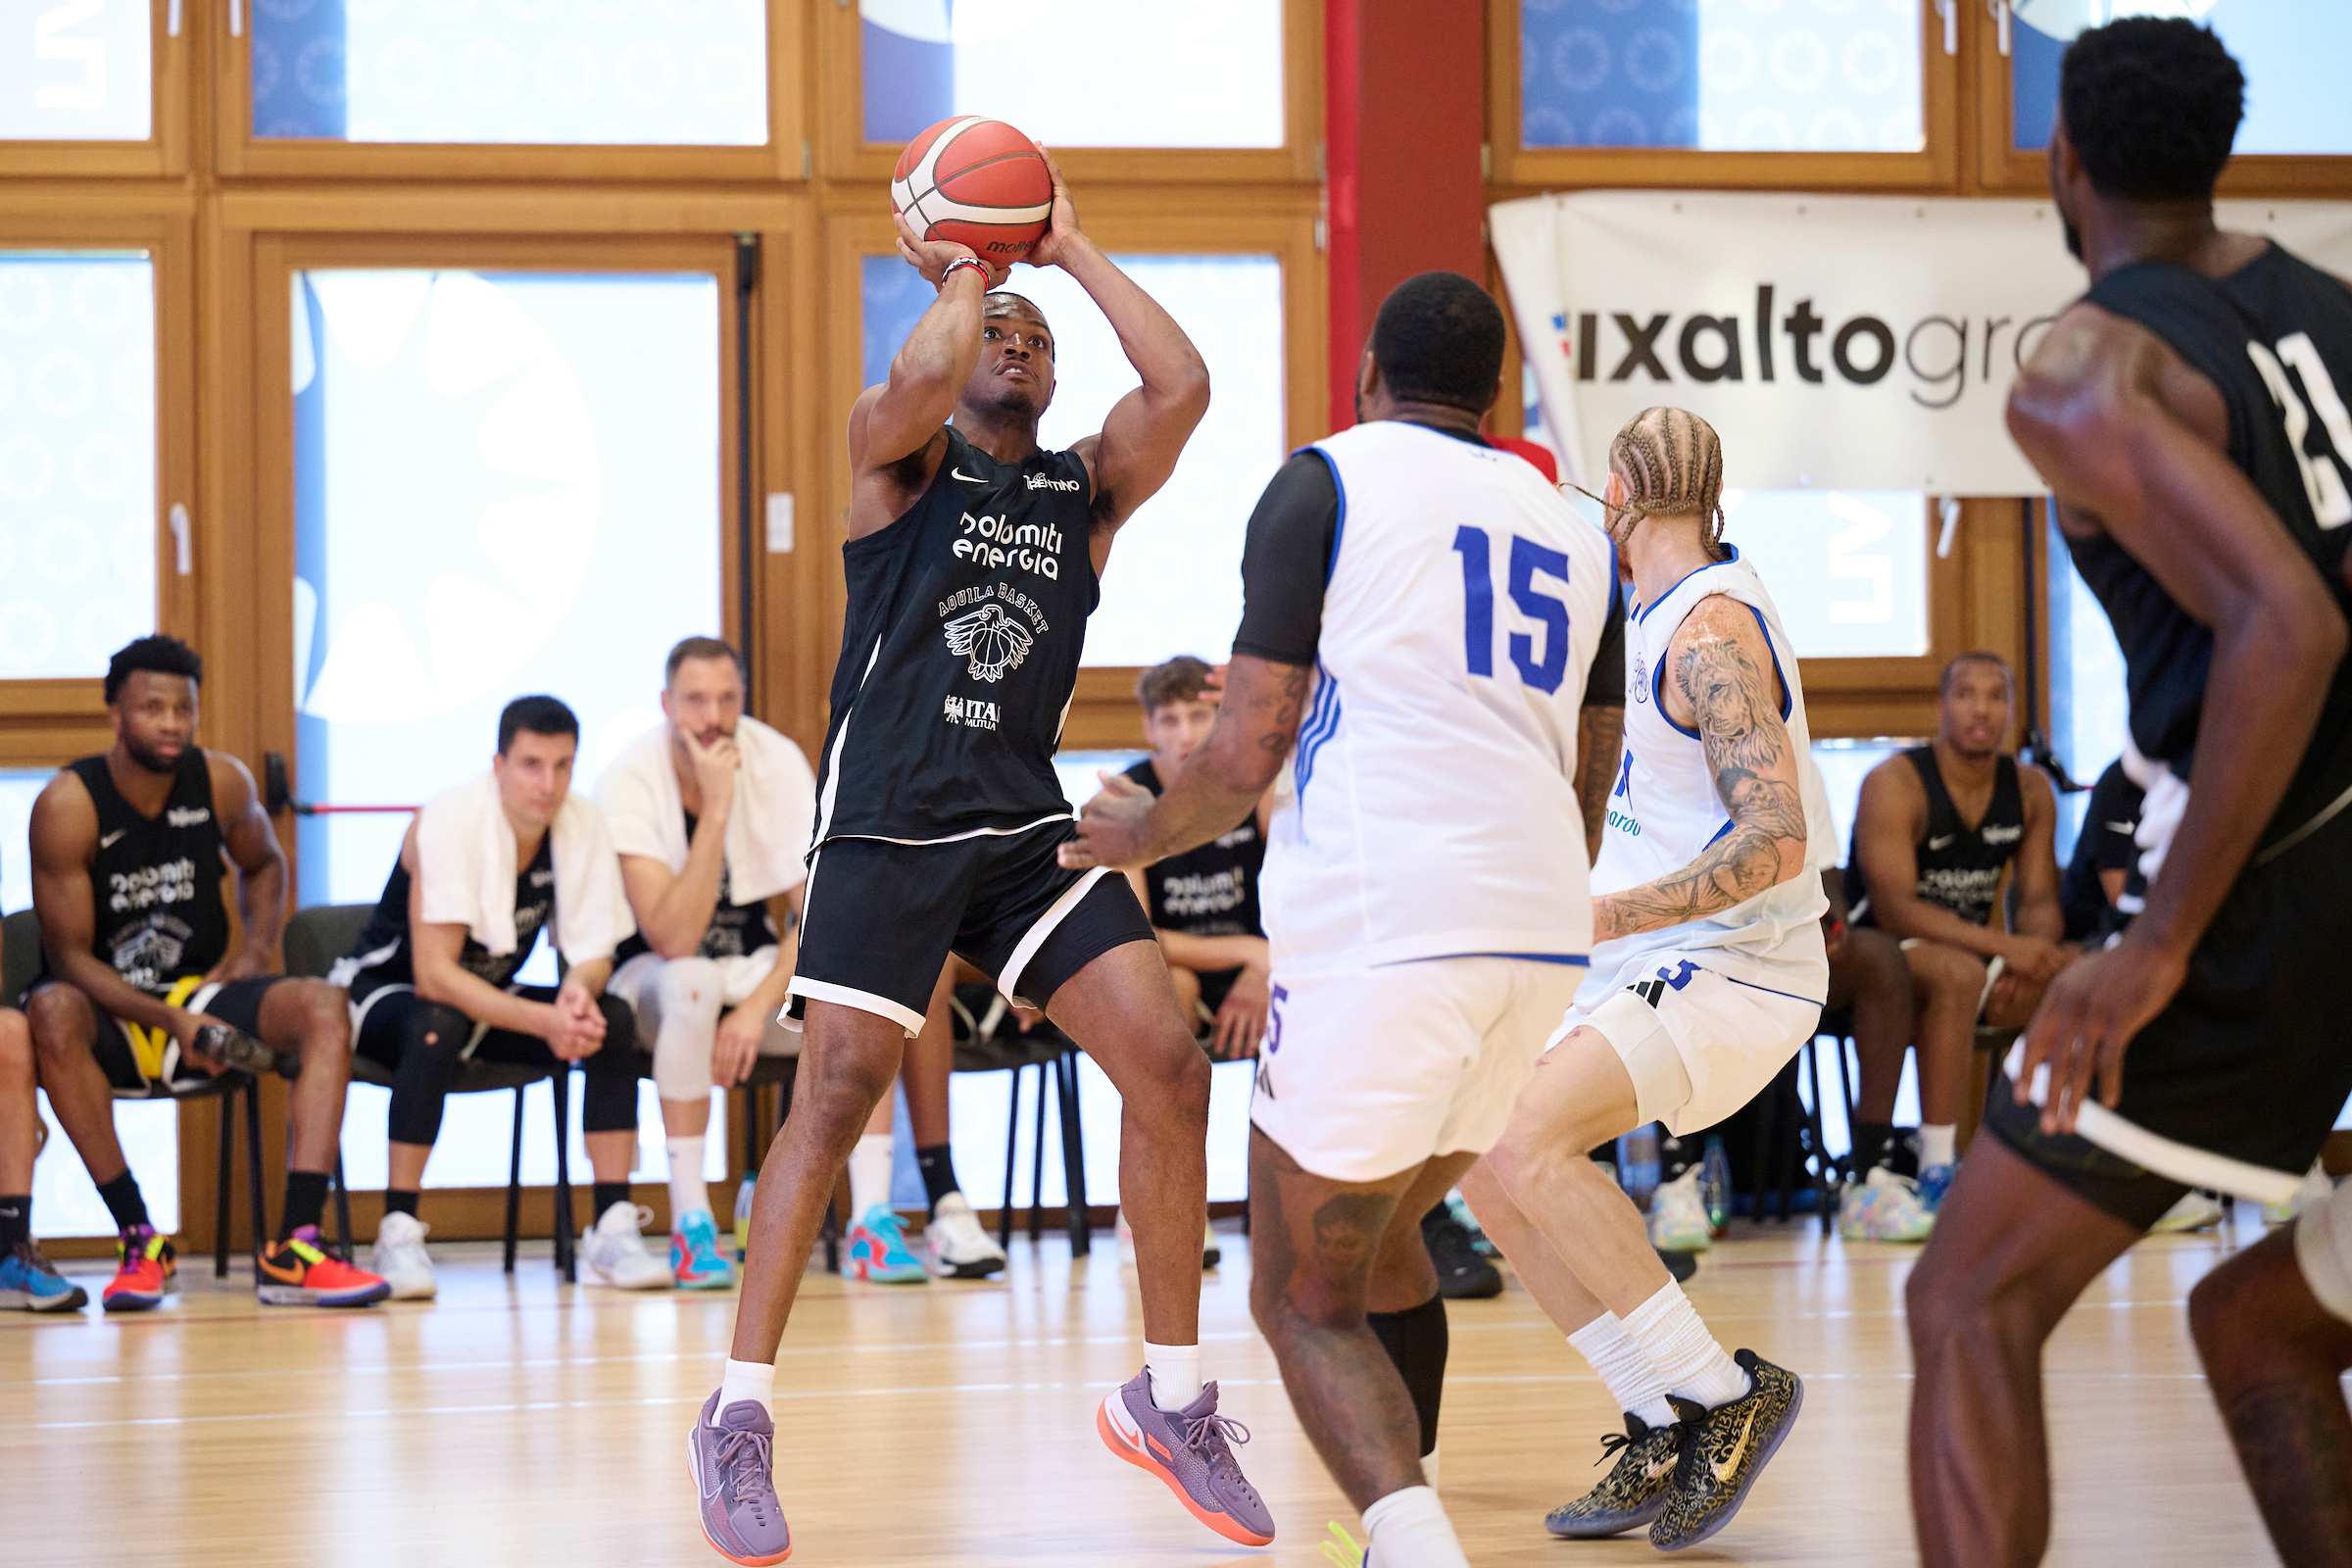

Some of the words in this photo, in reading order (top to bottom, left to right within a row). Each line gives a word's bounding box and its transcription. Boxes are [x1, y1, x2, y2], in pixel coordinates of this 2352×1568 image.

[2246, 330, 2352, 530] 21
[1023, 473, 1080, 492] TRENTINO
[938, 585, 995, 617] AQUILA
[997, 581, 1050, 634] BASKET
[1452, 524, 1570, 697] 15
[963, 718, 997, 732] MUTUA
